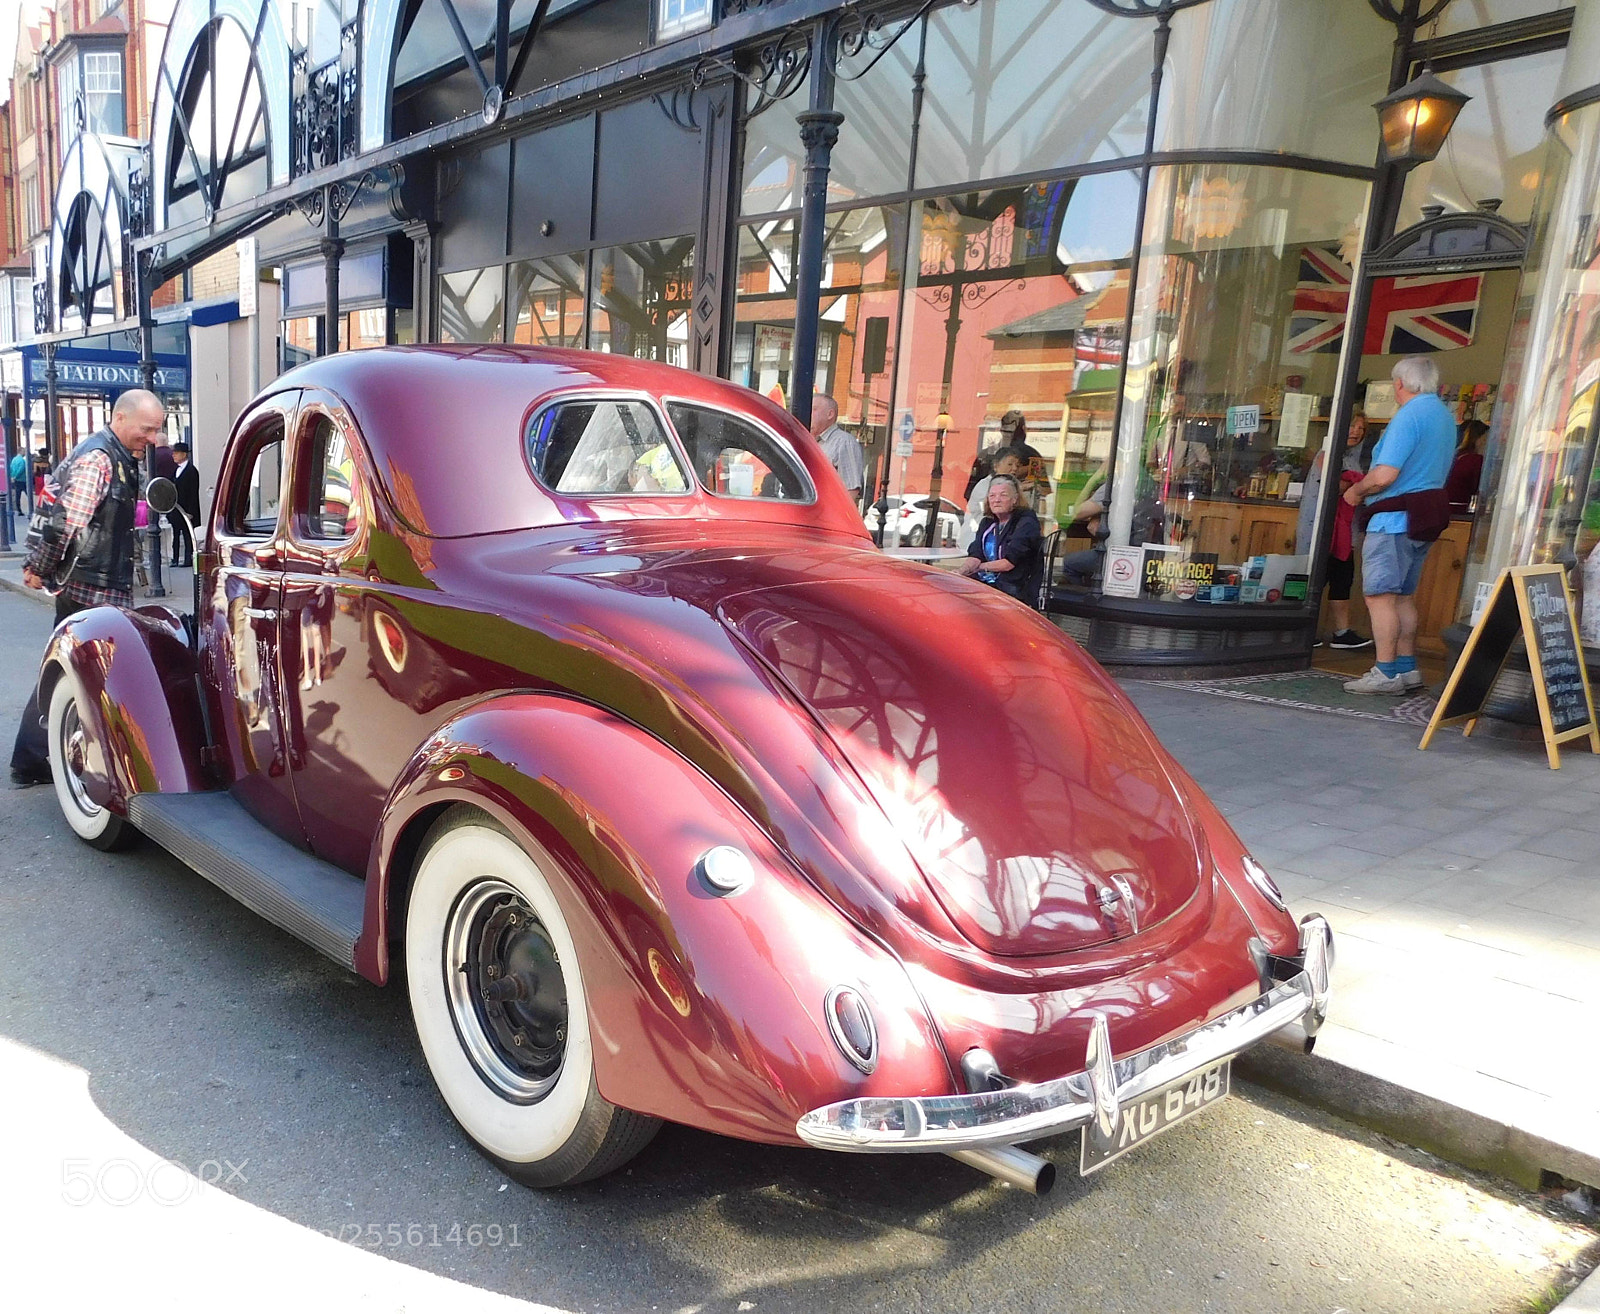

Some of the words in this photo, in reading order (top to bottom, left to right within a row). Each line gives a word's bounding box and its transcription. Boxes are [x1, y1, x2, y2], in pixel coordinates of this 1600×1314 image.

[54, 364, 169, 385] TATIONEY
[1232, 411, 1257, 428] OPEN
[1146, 559, 1183, 579] C'MON
[1187, 562, 1215, 580] RGC!
[1165, 1065, 1221, 1121] 648
